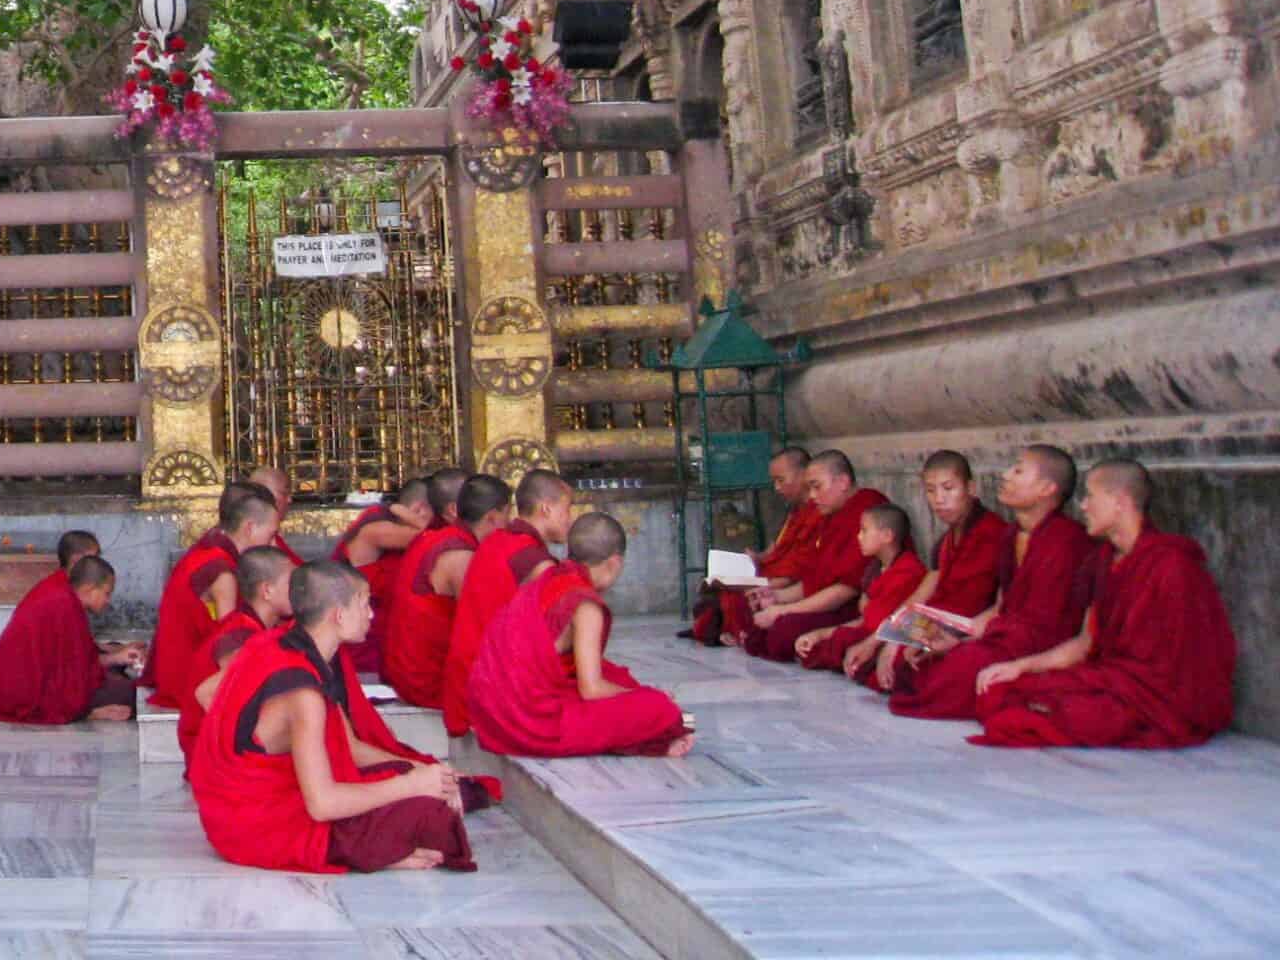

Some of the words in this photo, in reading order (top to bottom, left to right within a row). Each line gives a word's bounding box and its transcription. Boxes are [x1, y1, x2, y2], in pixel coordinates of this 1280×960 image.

[277, 241, 295, 250] THIS
[299, 241, 322, 250] PLACE
[360, 238, 376, 248] FOR
[277, 255, 307, 264] PRAYER
[331, 252, 376, 263] MEDITATION
